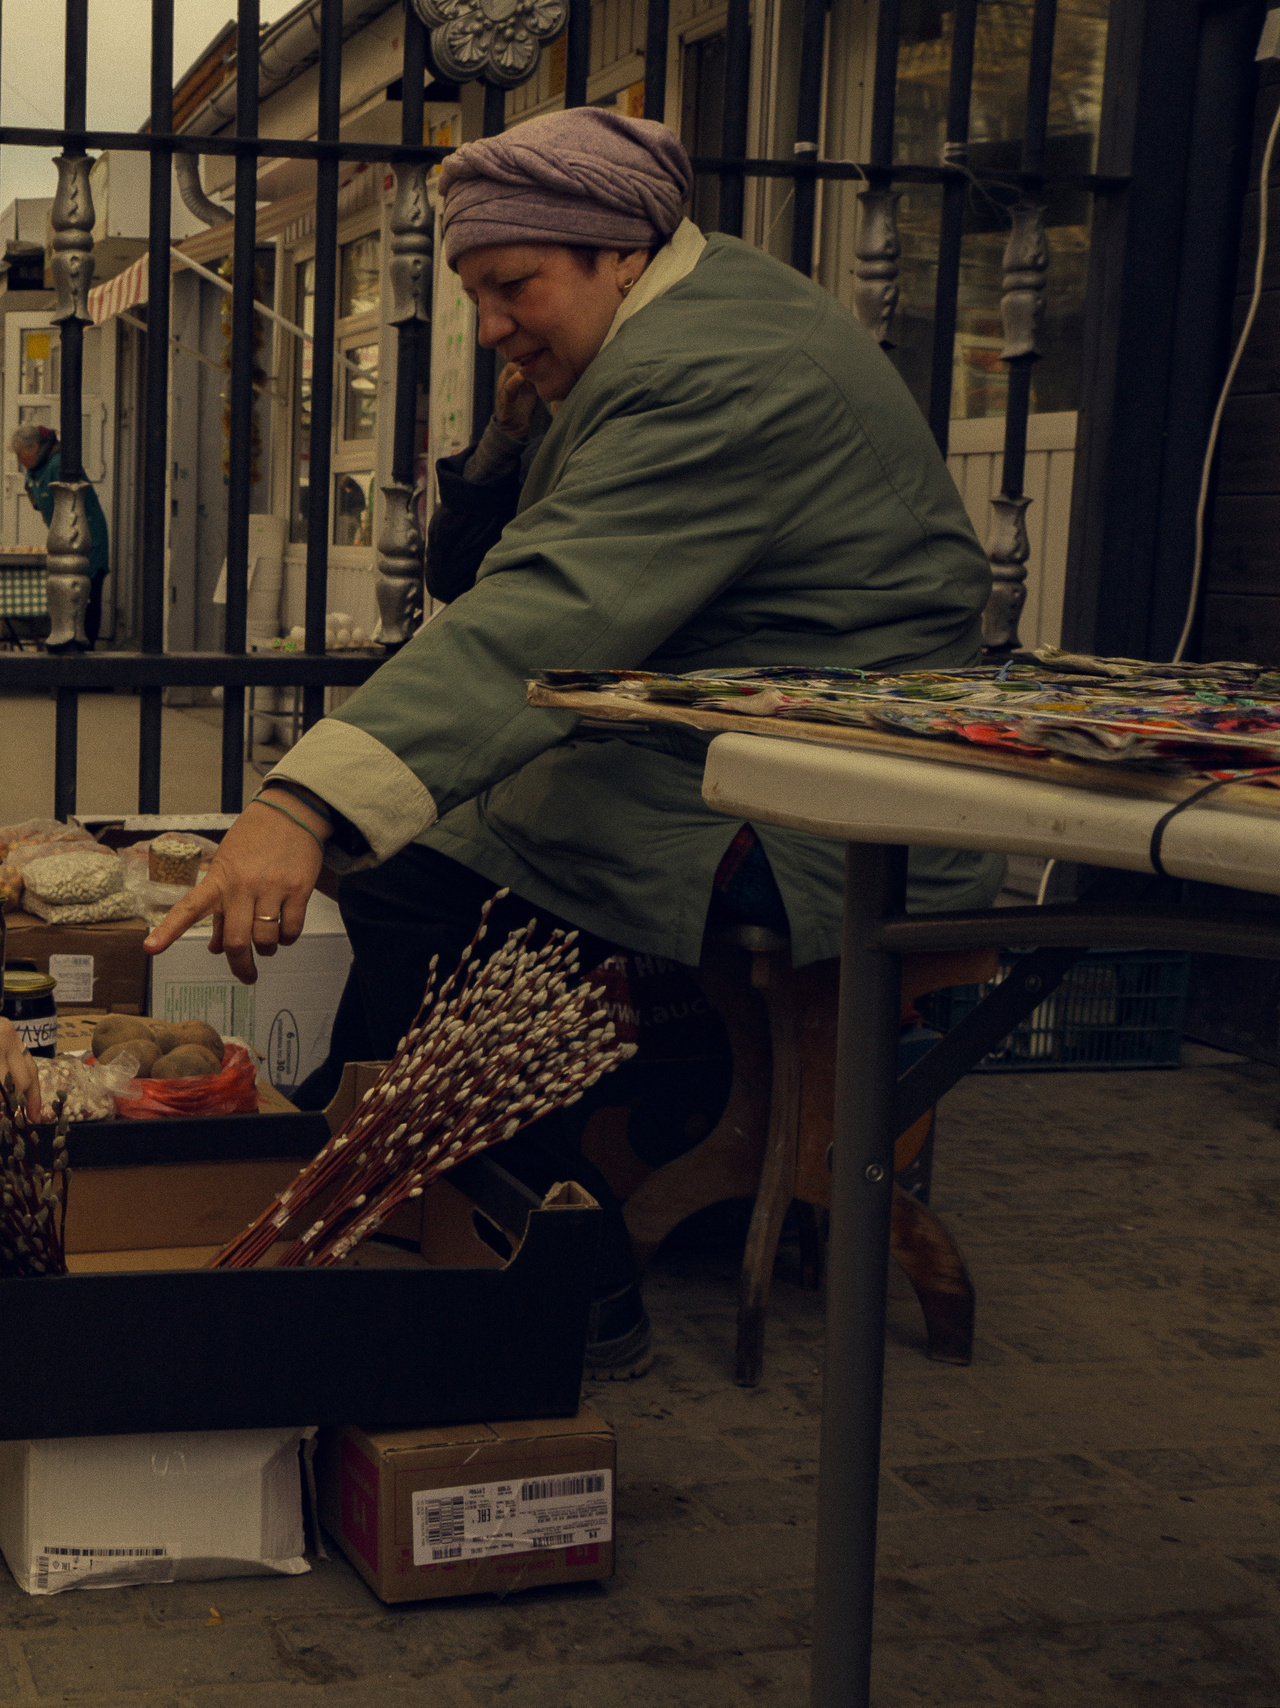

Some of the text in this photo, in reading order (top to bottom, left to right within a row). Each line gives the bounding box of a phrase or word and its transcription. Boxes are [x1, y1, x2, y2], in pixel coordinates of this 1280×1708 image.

[16, 1023, 57, 1047] ЛУБН
[286, 1031, 295, 1039] 6
[277, 1059, 285, 1072] 30
